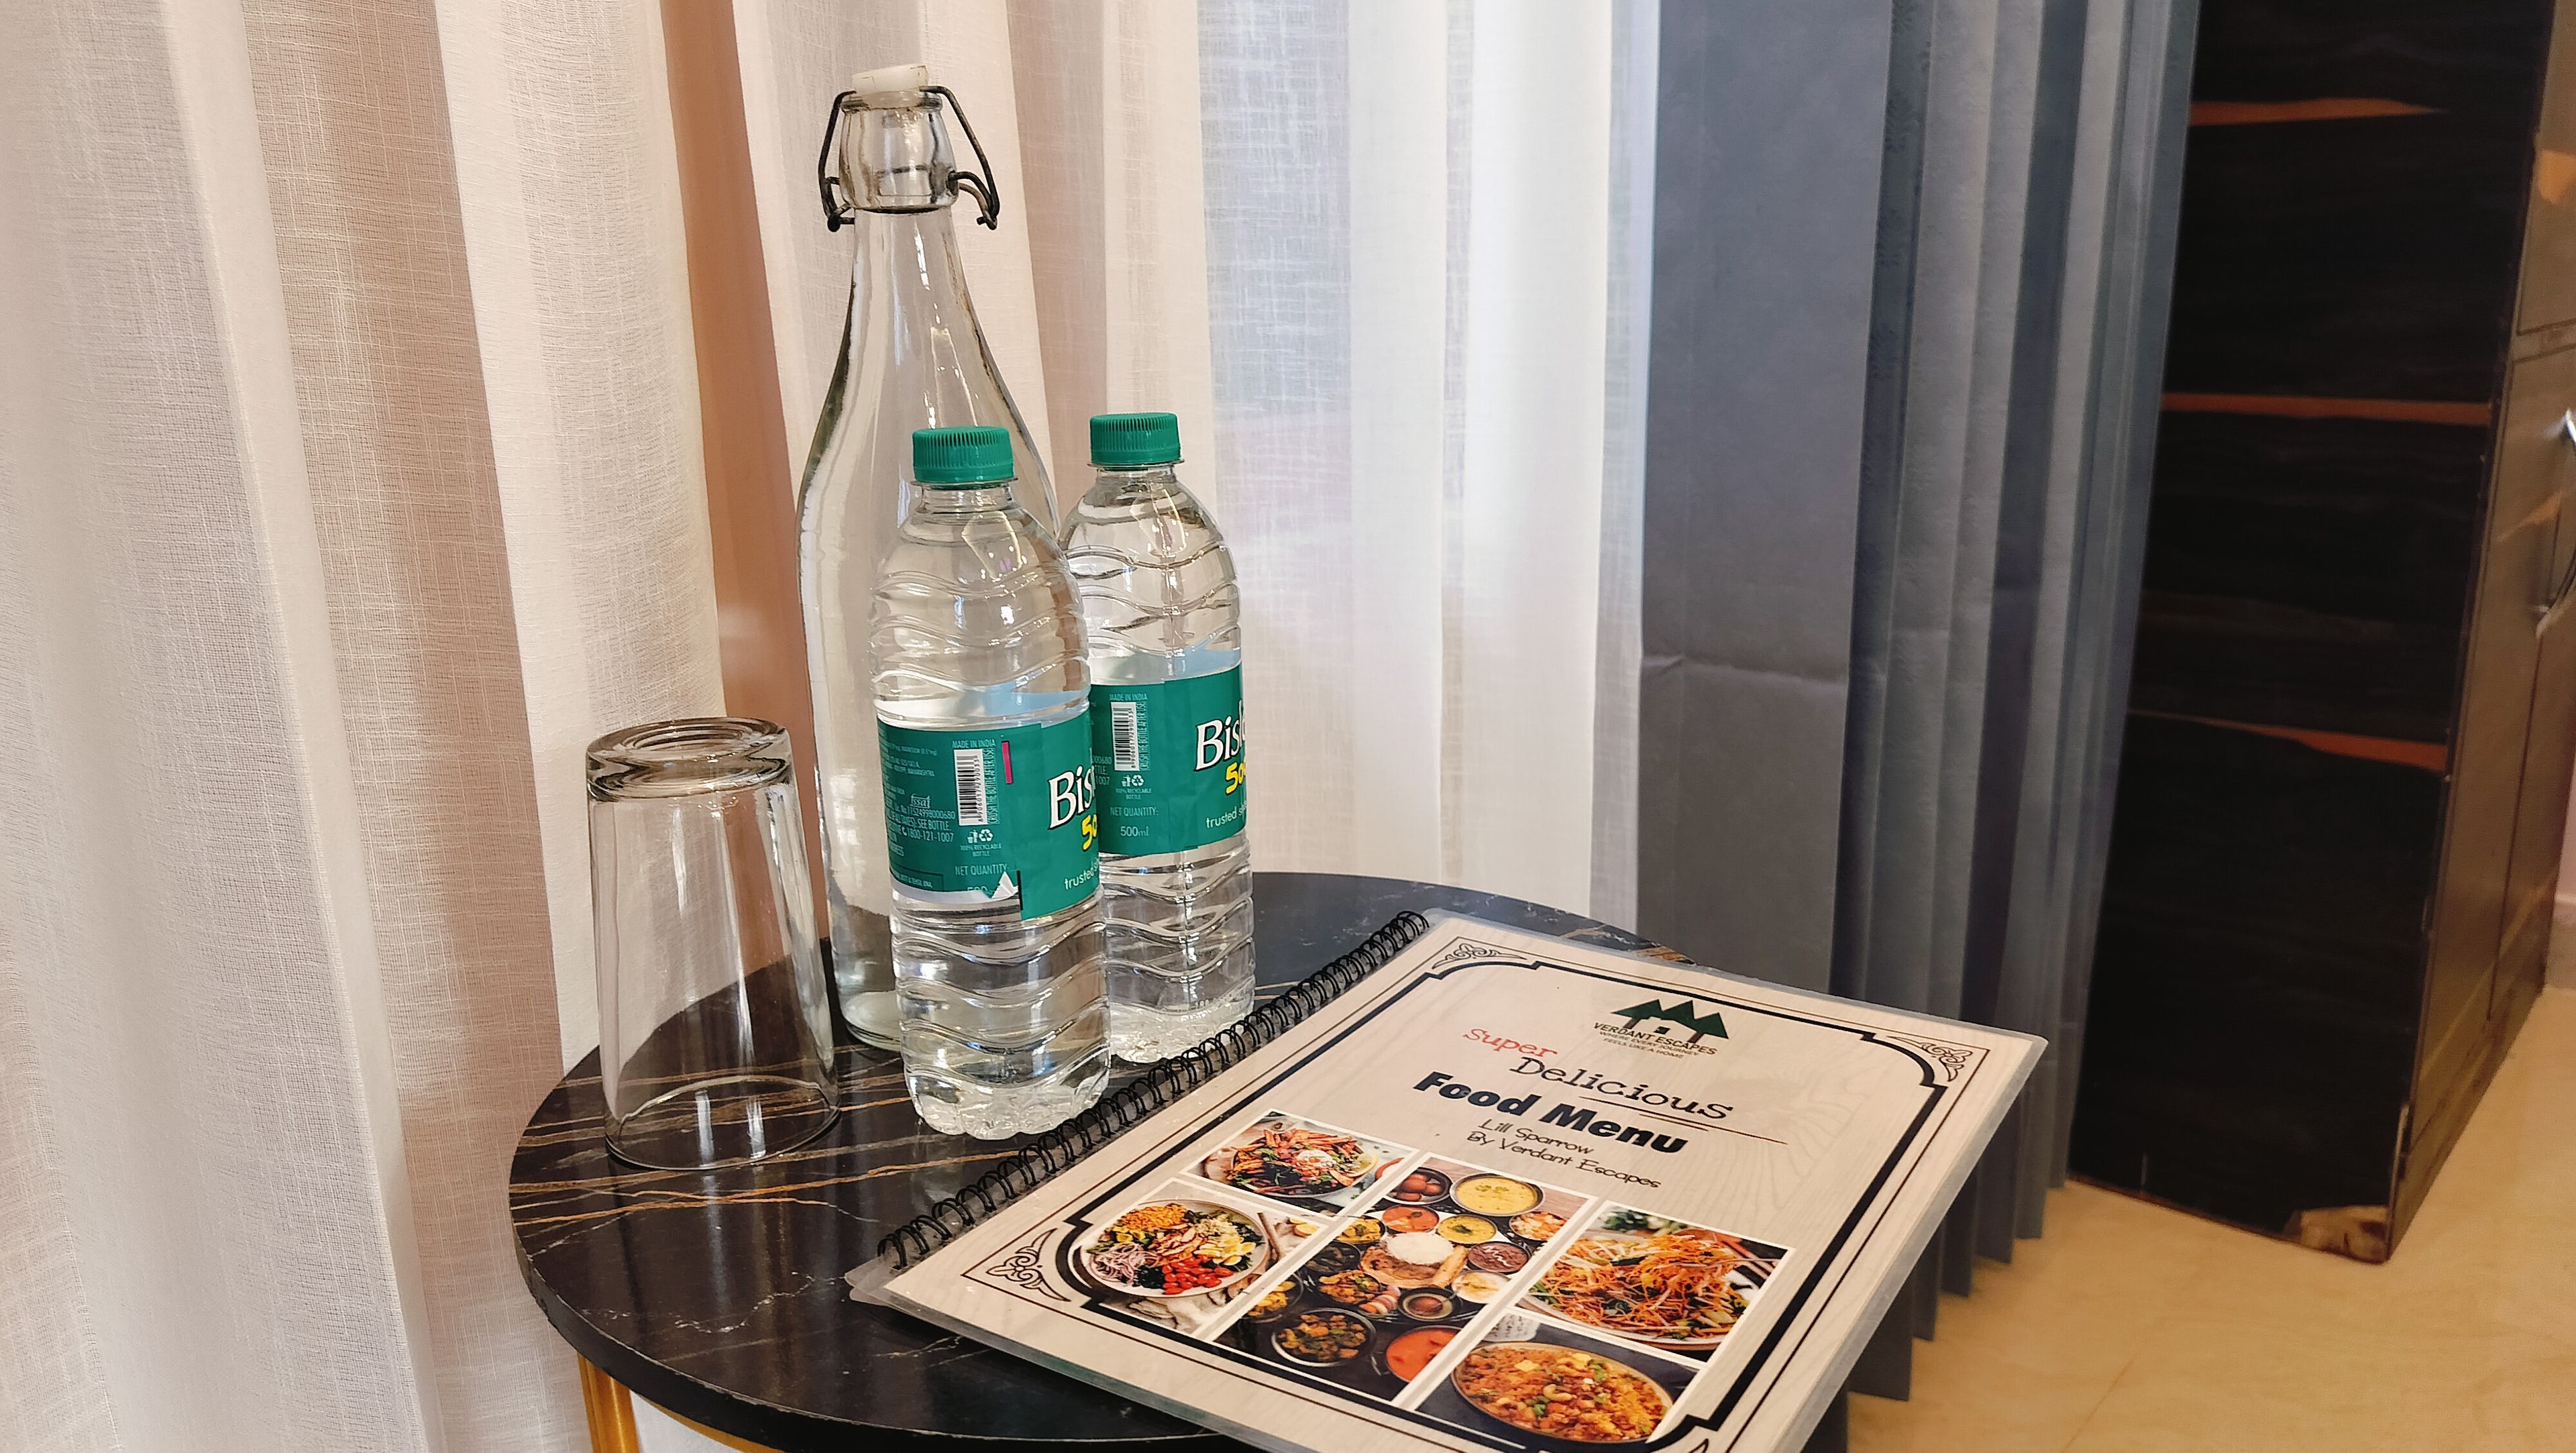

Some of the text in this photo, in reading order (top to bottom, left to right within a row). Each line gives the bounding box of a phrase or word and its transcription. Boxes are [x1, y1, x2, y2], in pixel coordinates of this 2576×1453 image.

[1109, 692, 1148, 701] MADE IN INDIA
[1137, 712, 1147, 727] AFTER
[951, 739, 996, 749] MADE IN INDIA
[1138, 728, 1148, 744] BOTTLE
[1138, 745, 1148, 753] THE
[984, 759, 995, 776] AFTER
[1138, 754, 1148, 770] CRUSH
[985, 777, 997, 794] BOTTLE
[986, 795, 998, 805] THE
[986, 806, 998, 824] CRUSH
[1110, 807, 1122, 816] NET
[1206, 806, 1237, 828] trusted
[918, 818, 928, 830] SEE
[955, 865, 968, 875] NET
[1462, 1028, 1558, 1059] Super
[1593, 1022, 1718, 1055] VERDANT ESCAPES
[1599, 1031, 1700, 1056] WHERE EVERY JOURNEY
[1603, 1038, 1627, 1046] FEELS
[1628, 1042, 1648, 1051] LIKE
[1656, 1049, 1685, 1060] HOME
[1508, 1055, 1734, 1120] Delicious
[1412, 1071, 1689, 1154] Food Menu
[1477, 1118, 1596, 1155] Lill Sparrow
[1466, 1130, 1663, 1189] By Verdant Escapes
